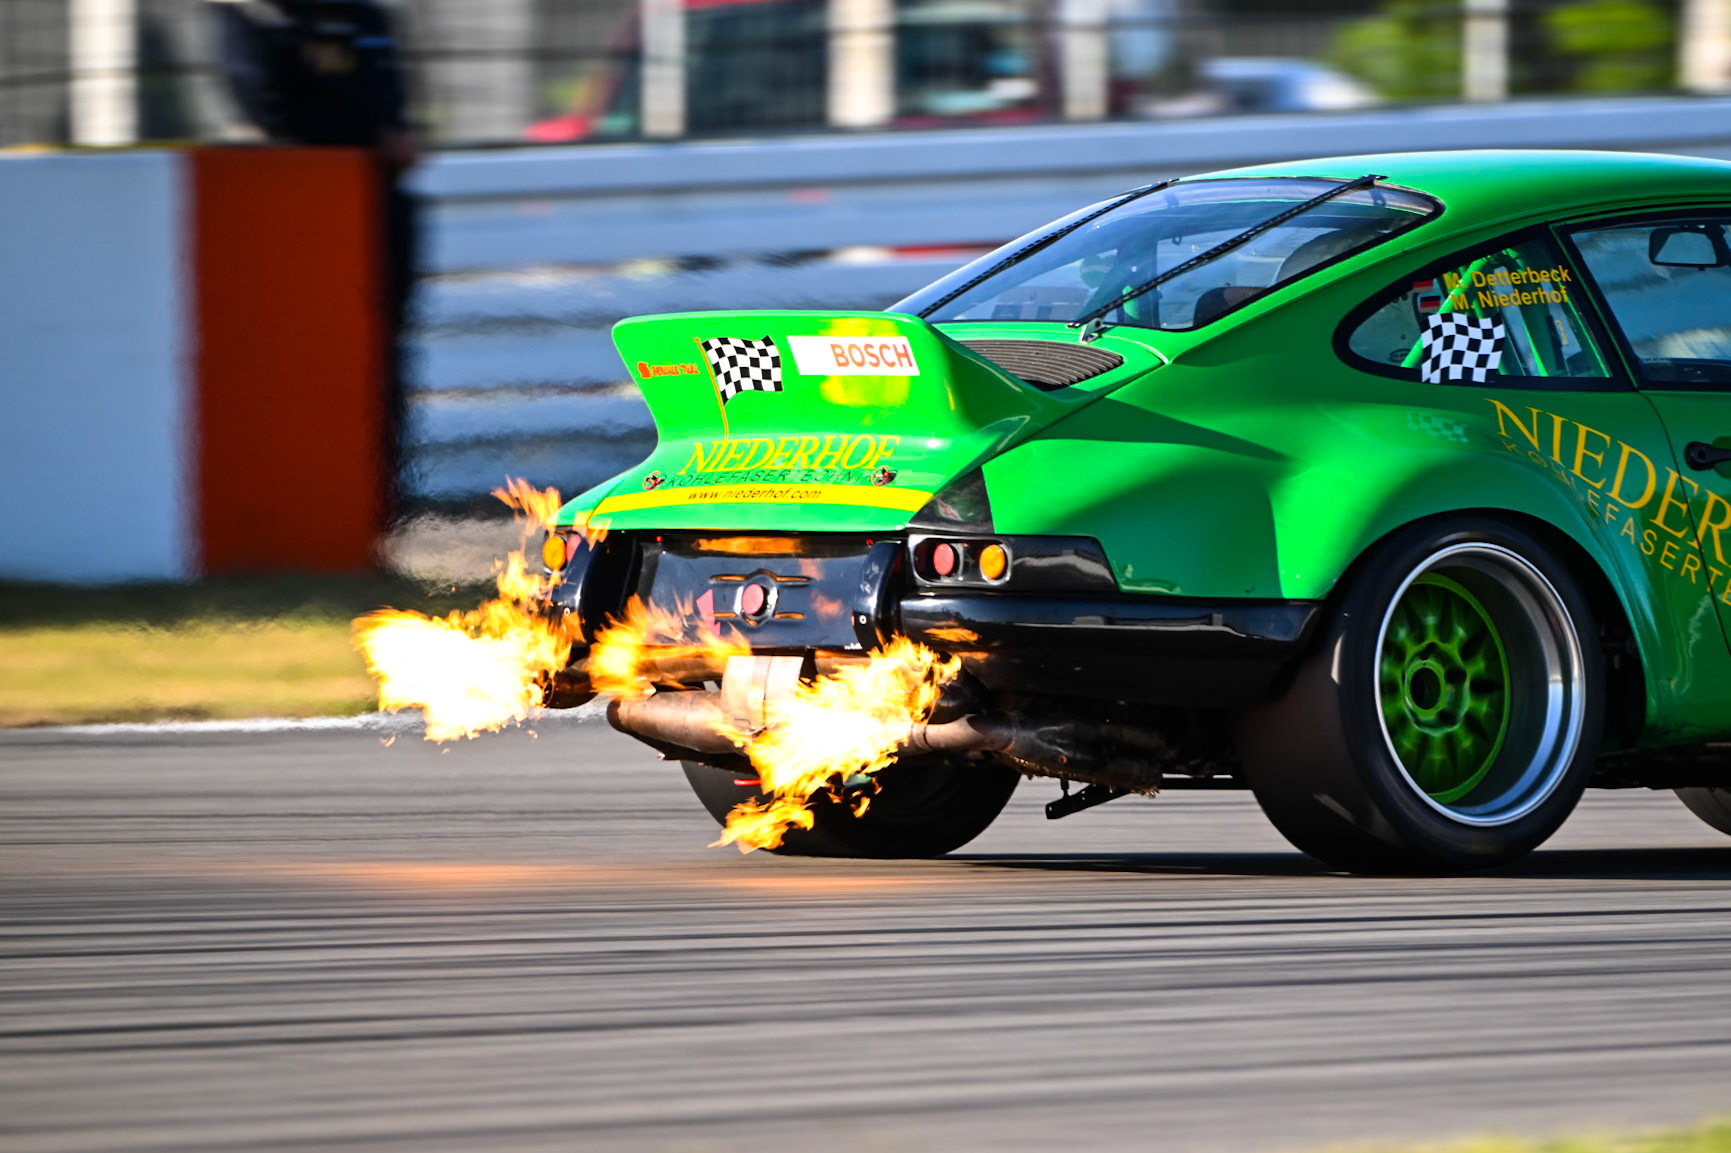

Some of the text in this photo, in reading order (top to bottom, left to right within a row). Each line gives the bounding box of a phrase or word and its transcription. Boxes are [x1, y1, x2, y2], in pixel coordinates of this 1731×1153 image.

[1470, 265, 1572, 288] Detterbeck
[1452, 285, 1569, 310] M. Niederhof
[829, 343, 913, 368] BOSCH
[677, 434, 901, 475] NIEDERHOF
[687, 487, 822, 500] www.niederhof.com
